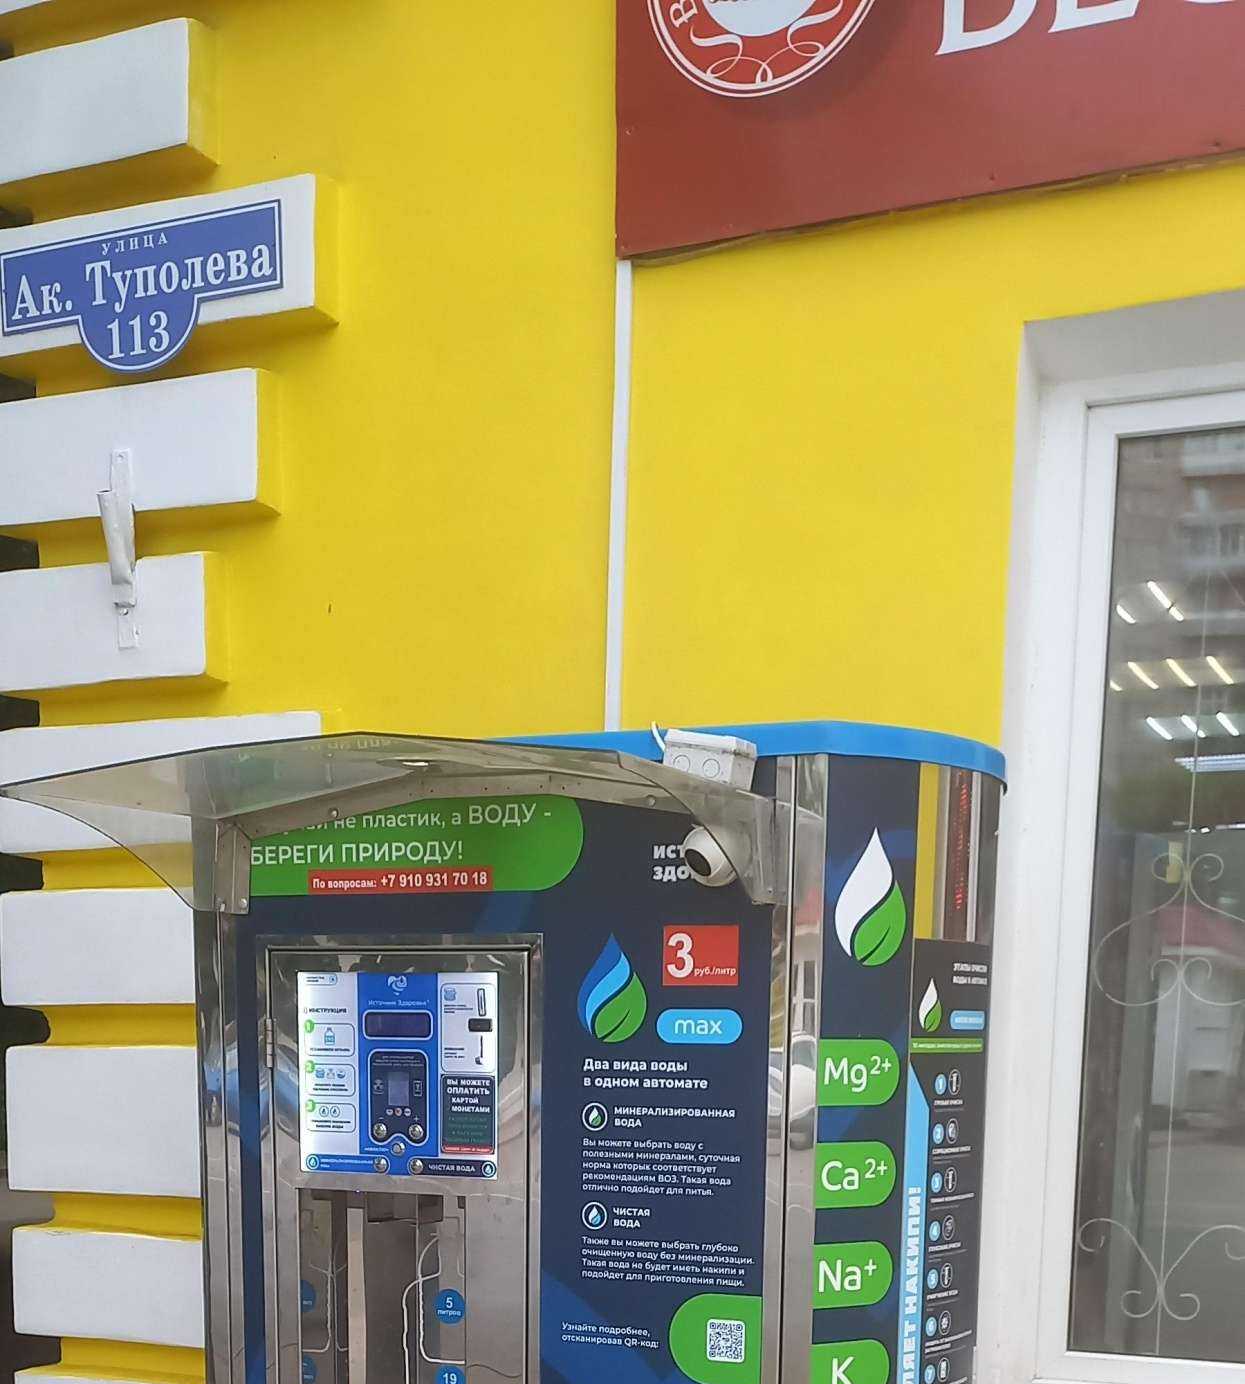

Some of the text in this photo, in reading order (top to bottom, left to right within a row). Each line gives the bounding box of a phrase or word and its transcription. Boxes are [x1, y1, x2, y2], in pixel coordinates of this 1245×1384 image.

[102, 231, 169, 255] УЛИЦА
[12, 243, 273, 320] Ак. Туполева
[106, 310, 170, 359] 113
[335, 815, 355, 829] не
[362, 812, 445, 829] пластик,
[452, 812, 461, 825] а
[469, 804, 536, 827] ВОДУ
[252, 840, 463, 866] БЕРЕГИ ПРИРОДУ!
[313, 872, 487, 891] По вопросам: +7 910 931 70 18
[667, 933, 736, 979] 3 руб./литр
[674, 1018, 722, 1034] max
[583, 1058, 687, 1071] Два вида воды
[584, 1077, 708, 1089] в одном автомате
[452, 1105, 490, 1113] МОНЕТАМИ
[614, 1107, 735, 1118] МИНЕРАЛИЗИРОВАННАЯ
[614, 1119, 641, 1127] ВОДА
[583, 1138, 596, 1146] Вы
[634, 1141, 672, 1149] выбрать
[674, 1142, 696, 1151] воду
[583, 1151, 740, 1163] полезными минералами, суточная
[583, 1162, 611, 1170] норма
[653, 1164, 716, 1173] соответствует
[583, 1173, 731, 1186] рекомендациям ВОЗ. Такая вода
[583, 1183, 713, 1196] отлично подойдет для питья.
[613, 1208, 650, 1216] ЧИСТАЯ
[614, 1220, 640, 1228] ВОДА
[583, 1237, 738, 1252] Также вы можете выбрать глубоко
[905, 1187, 922, 1314] НАКИПИ!
[582, 1249, 755, 1265] очищенную воду без минерализации.
[582, 1258, 606, 1267] Такая
[609, 1260, 629, 1269] вода
[645, 1262, 670, 1272] будет
[673, 1264, 700, 1272] иметь
[703, 1266, 735, 1274] накипи
[582, 1270, 744, 1287] подойдет для приготовления пищи.
[446, 1298, 453, 1308] 5
[562, 1322, 650, 1336] Узнайте подробнее,
[562, 1334, 659, 1349] отсканировав QR-код:
[443, 1374, 457, 1384] 19
